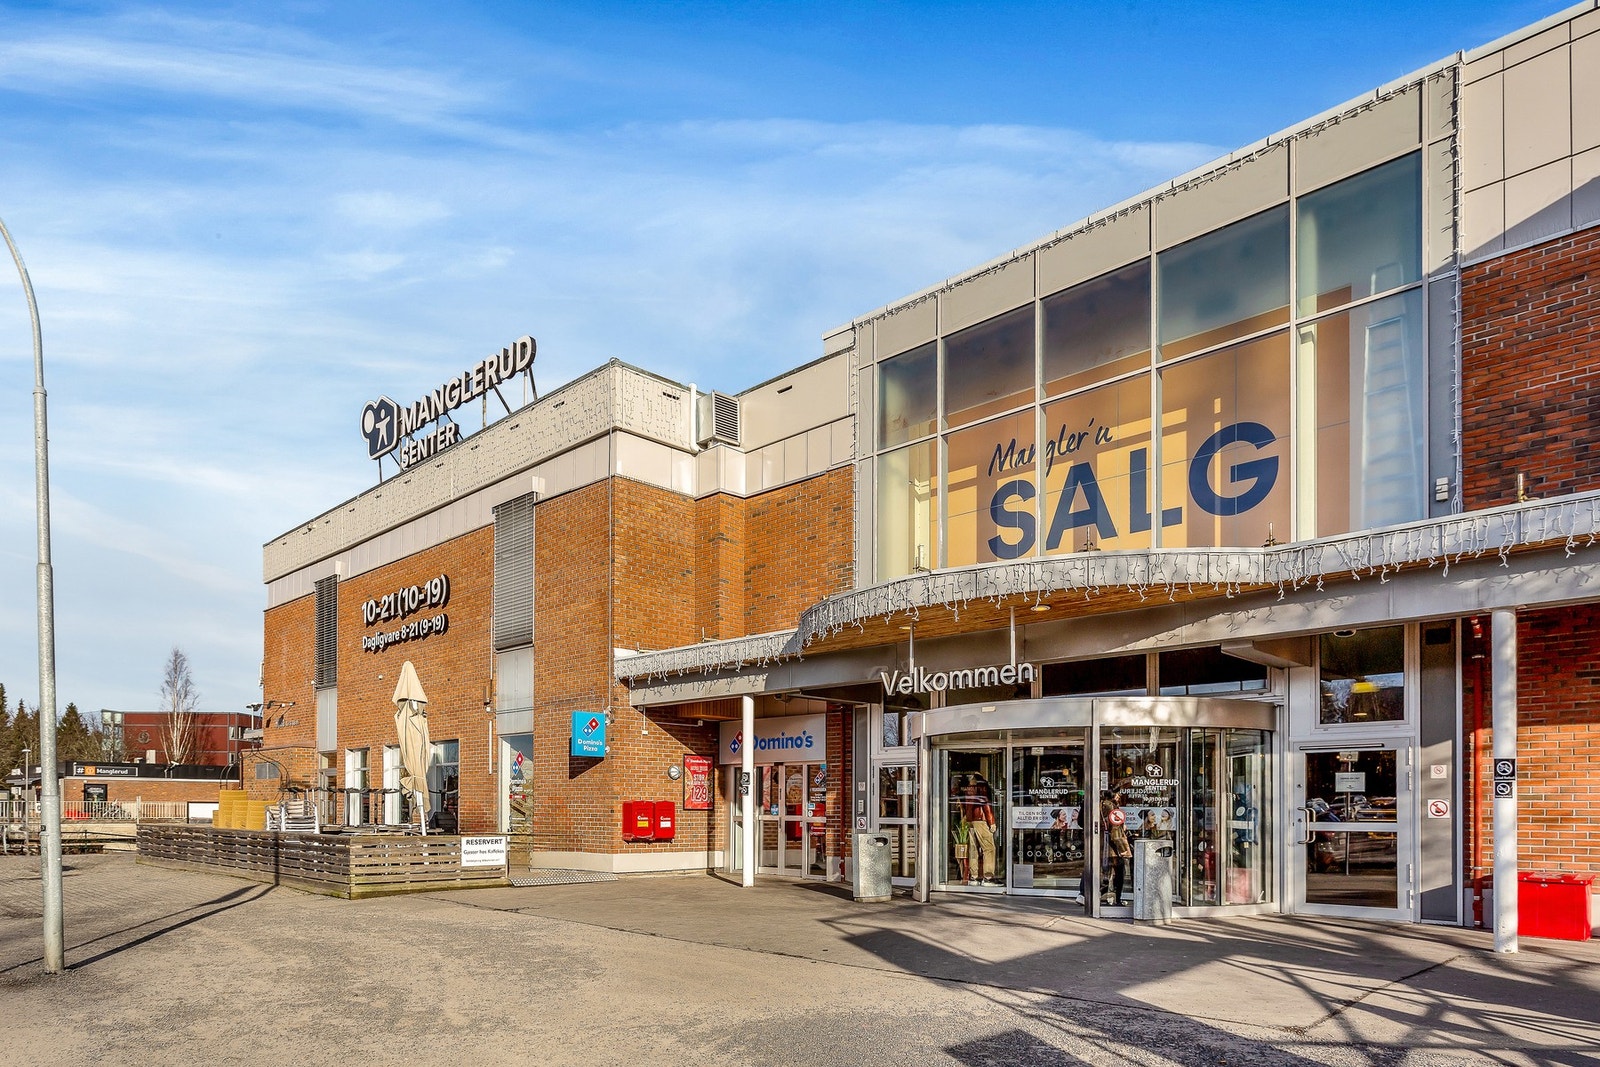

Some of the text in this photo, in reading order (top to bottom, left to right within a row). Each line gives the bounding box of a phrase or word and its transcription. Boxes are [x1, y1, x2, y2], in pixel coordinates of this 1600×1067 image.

[400, 334, 536, 439] MANGLERUD
[401, 422, 458, 469] SENTER
[987, 421, 1280, 560] SALG
[361, 574, 448, 624] 10-21 (10-19)
[362, 613, 447, 650] Dagligvare 8-21 (9-19)
[880, 661, 1036, 696] Velkommen
[691, 785, 709, 802] 129
[465, 838, 503, 846] RESERVERT
